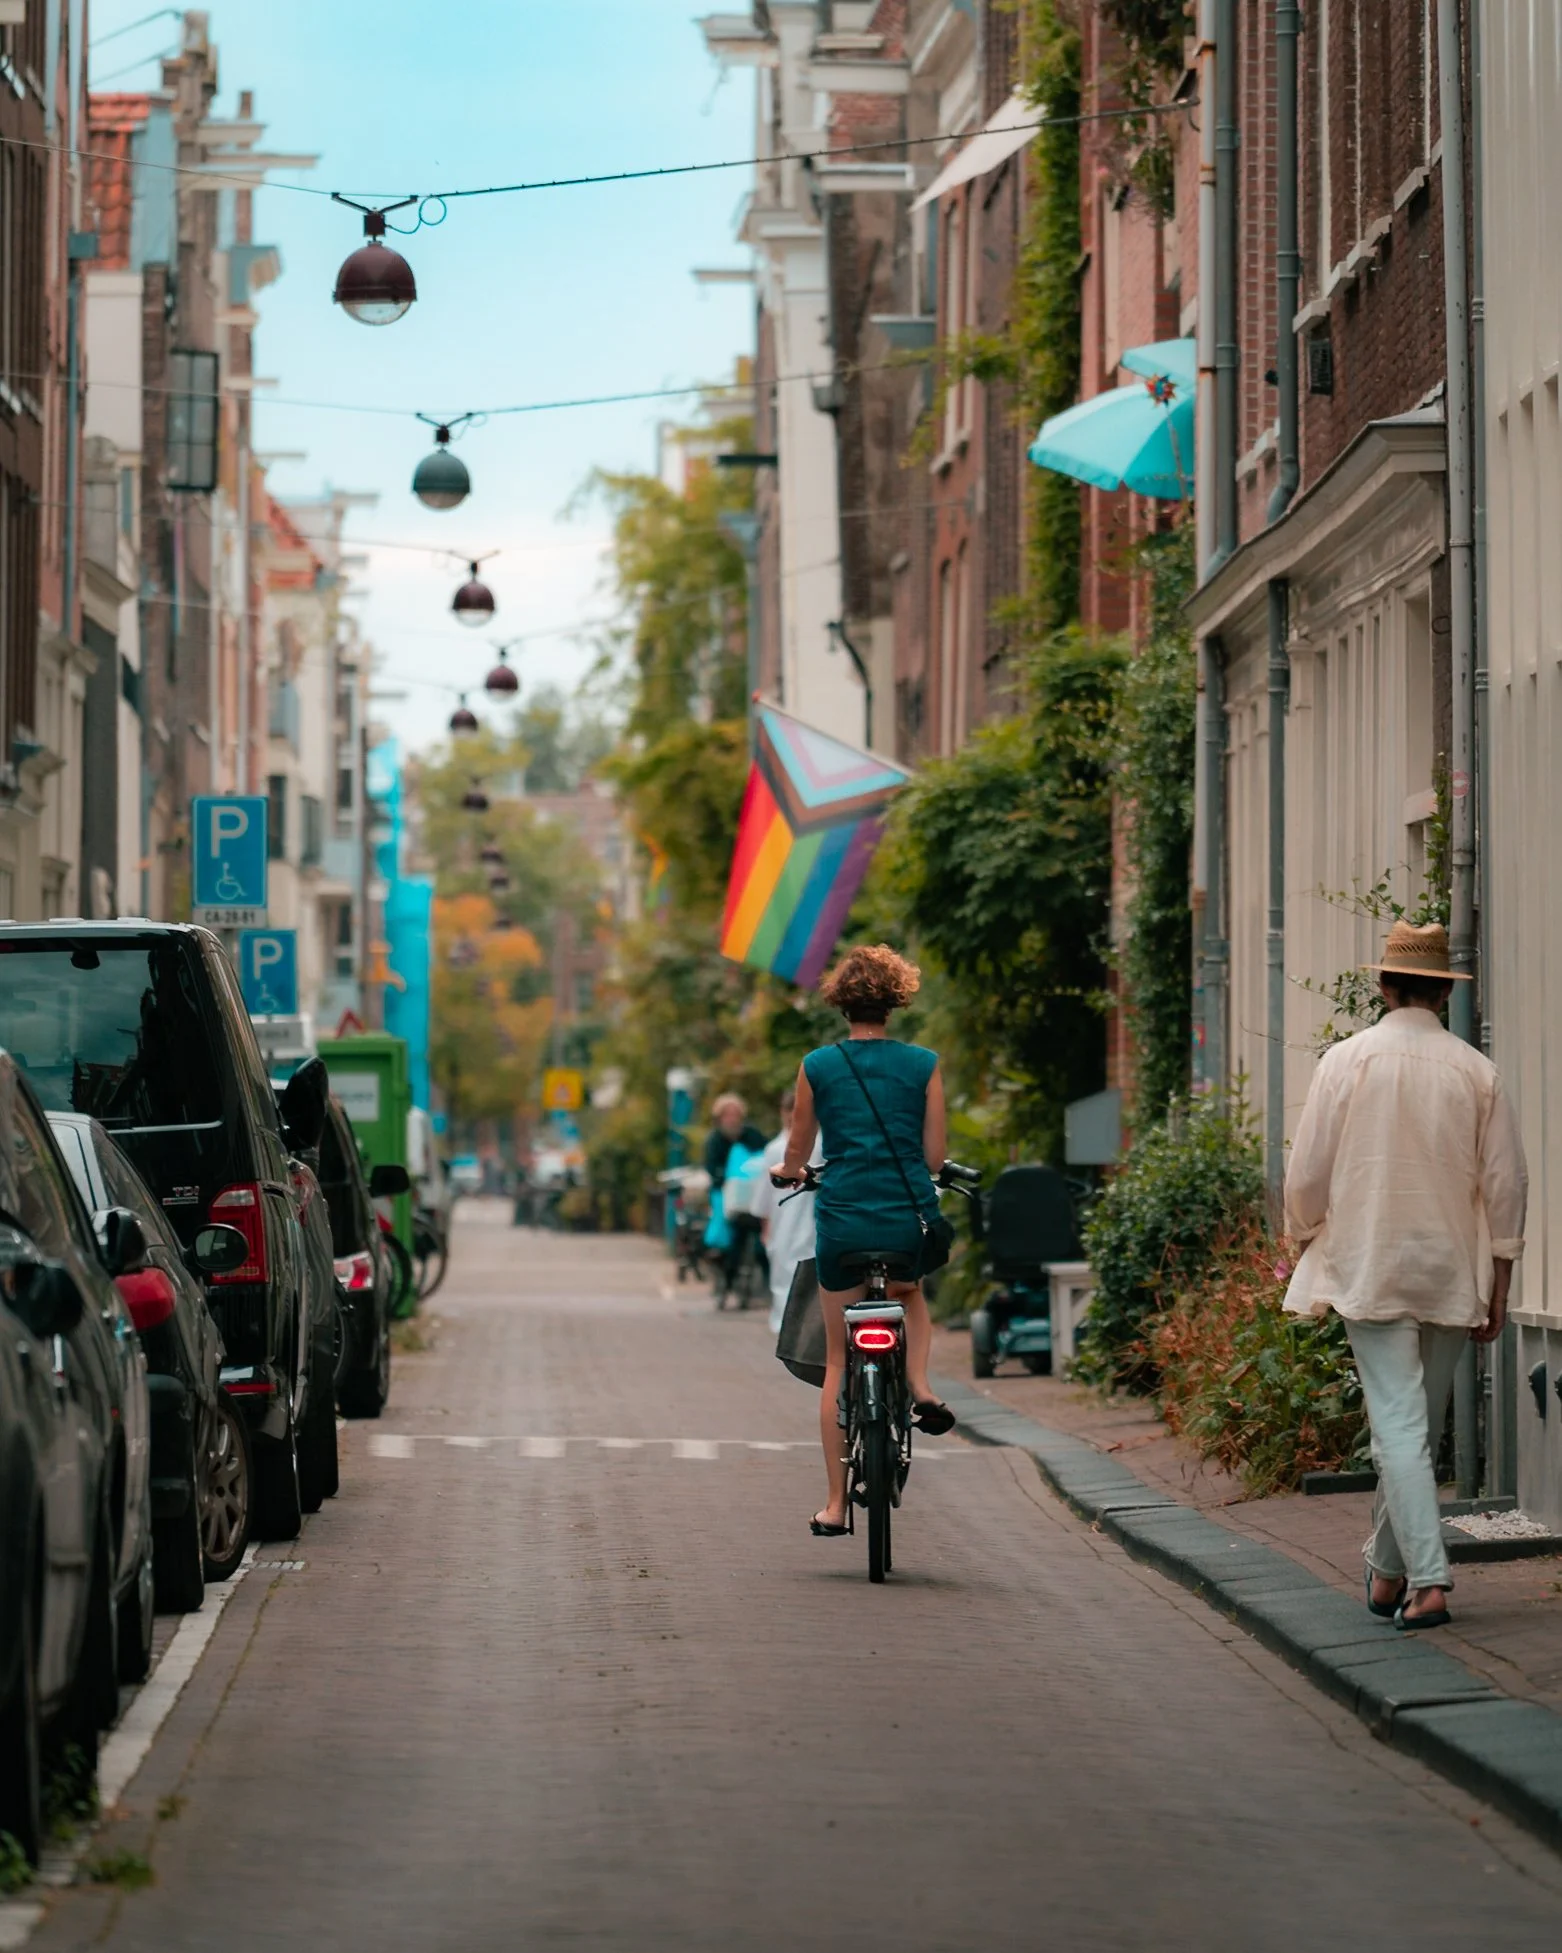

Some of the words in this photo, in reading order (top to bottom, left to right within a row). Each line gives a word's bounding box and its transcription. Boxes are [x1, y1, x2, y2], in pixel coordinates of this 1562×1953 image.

[210, 805, 249, 859] P
[253, 938, 283, 980] P
[172, 1185, 200, 1197] TDI
